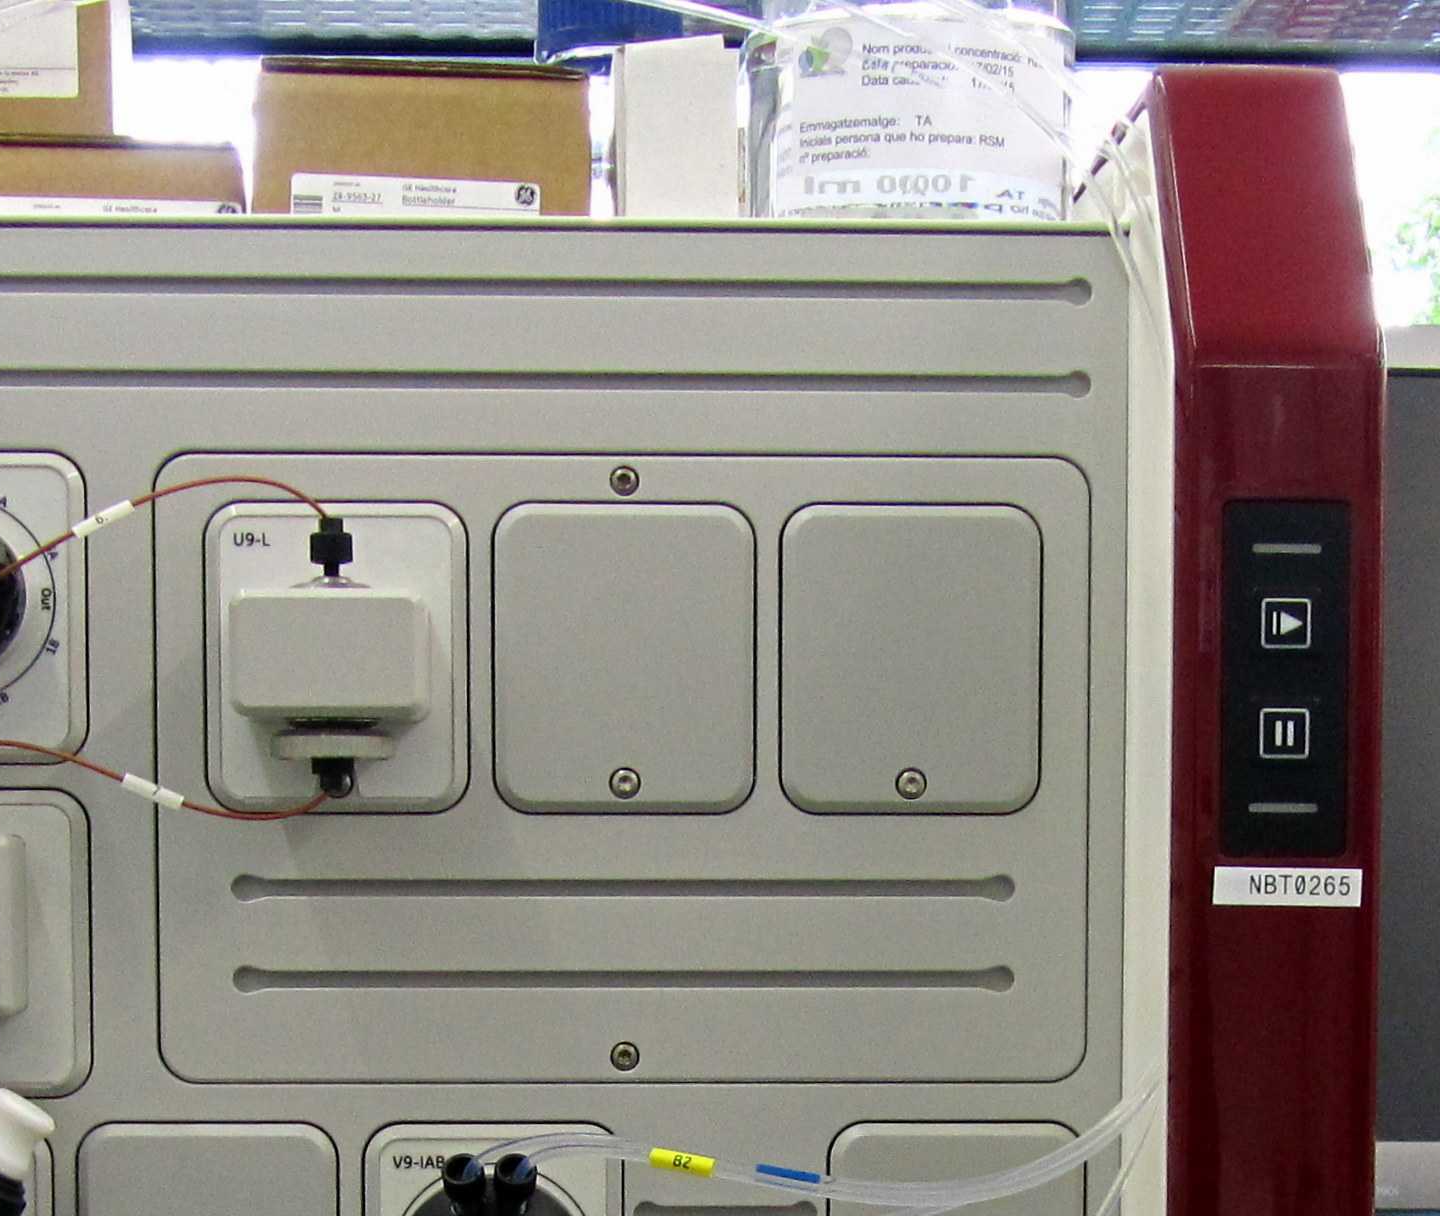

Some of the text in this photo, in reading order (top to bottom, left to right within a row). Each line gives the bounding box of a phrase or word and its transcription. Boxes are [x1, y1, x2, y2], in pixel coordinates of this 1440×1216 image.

[862, 43, 891, 54] Nom
[861, 75, 889, 87] Data
[916, 115, 933, 127] TA
[835, 134, 881, 146] persona
[884, 133, 907, 146] que
[910, 131, 925, 142] ho
[978, 135, 1006, 148] RSM
[232, 532, 271, 547] U9-L
[40, 587, 52, 611] Out
[1249, 874, 1351, 896] NBT0265
[393, 1155, 445, 1169] V9-IAB
